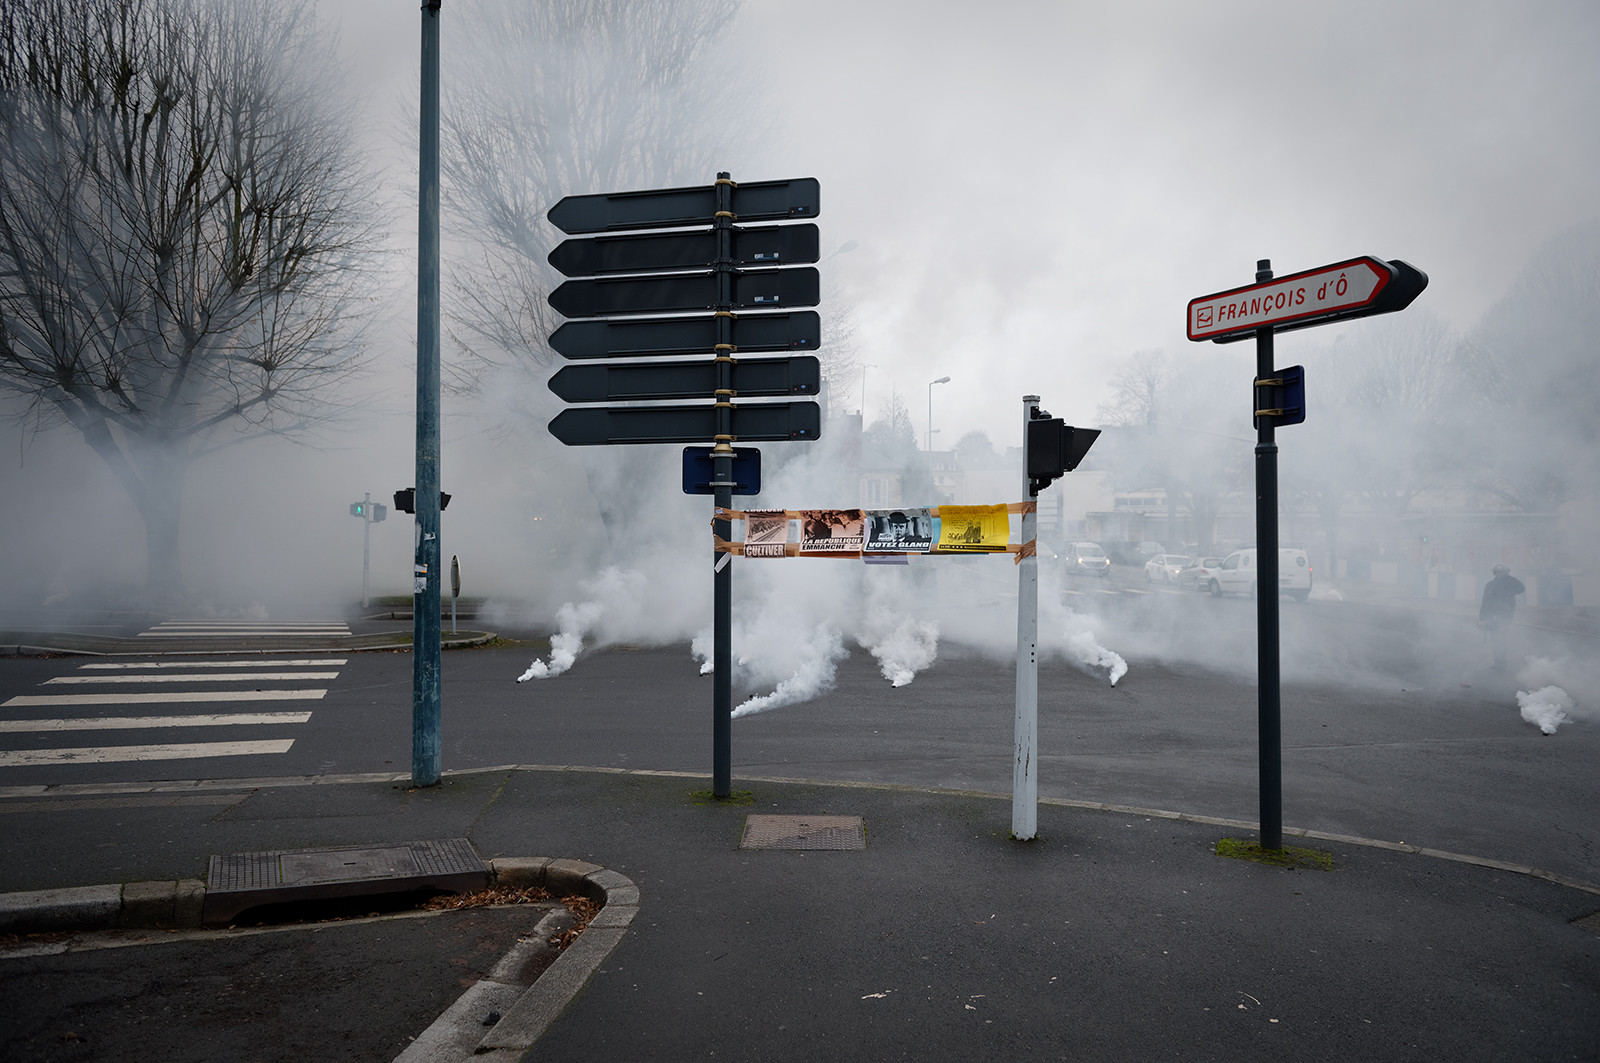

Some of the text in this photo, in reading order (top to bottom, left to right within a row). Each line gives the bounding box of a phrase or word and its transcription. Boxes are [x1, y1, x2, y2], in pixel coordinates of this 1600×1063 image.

[1218, 273, 1348, 322] FRANÇOIS d'Ô
[746, 544, 784, 556] CULTIVER
